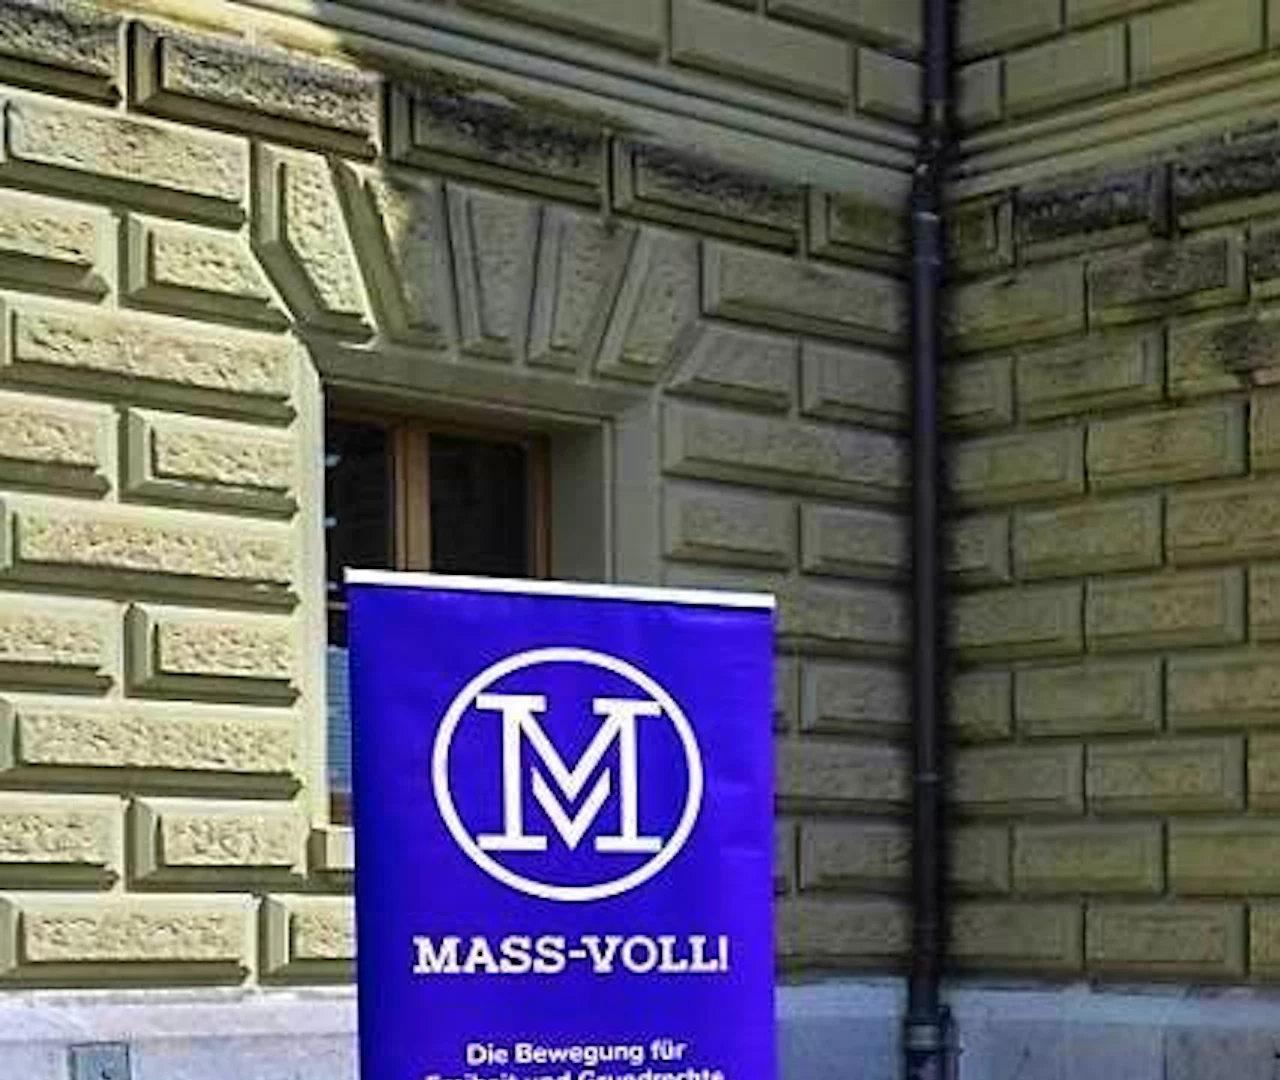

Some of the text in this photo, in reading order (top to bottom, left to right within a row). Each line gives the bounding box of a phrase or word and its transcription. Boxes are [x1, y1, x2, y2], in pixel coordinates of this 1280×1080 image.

[412, 935, 728, 974] MASS-VOLL!
[466, 1038, 688, 1067] Die Bewegung für
